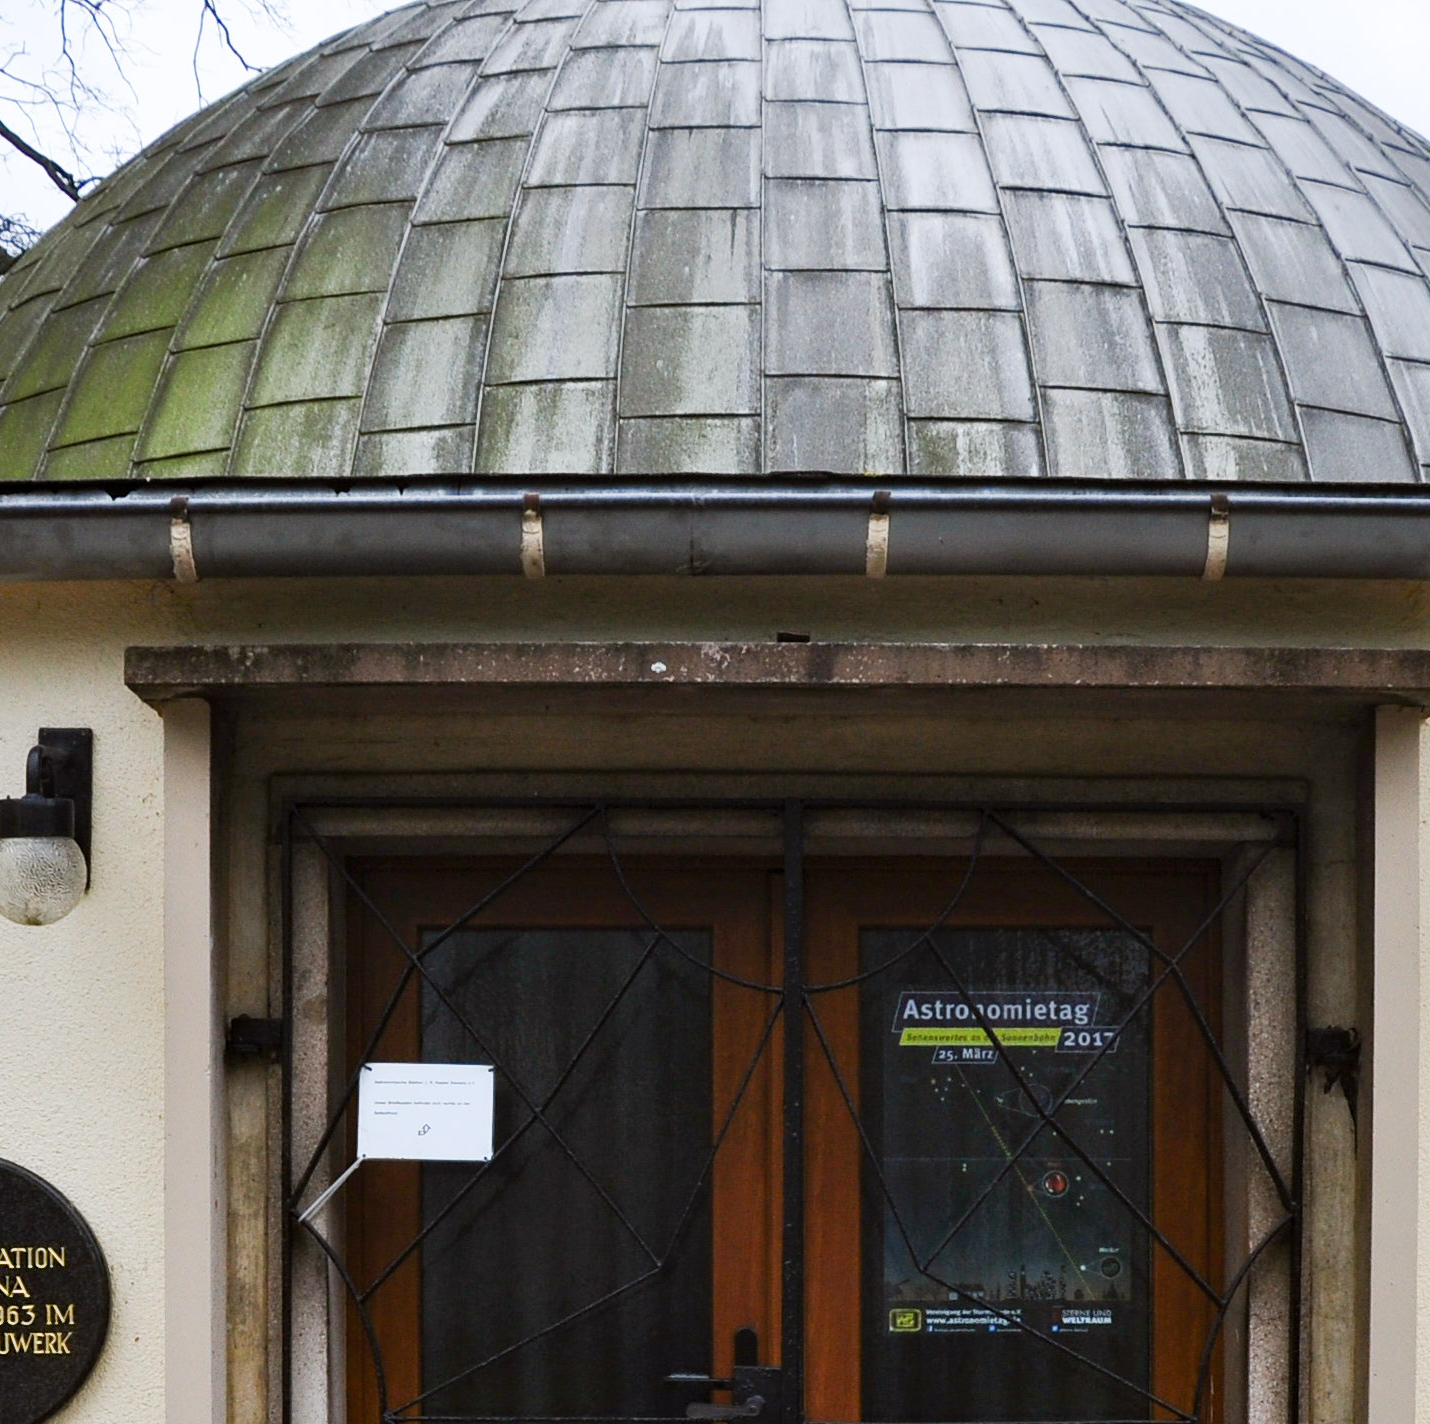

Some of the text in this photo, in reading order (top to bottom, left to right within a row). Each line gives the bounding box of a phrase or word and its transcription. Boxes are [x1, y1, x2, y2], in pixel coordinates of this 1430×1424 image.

[938, 1047, 994, 1061] 25. März
[45, 1303, 75, 1325] IM
